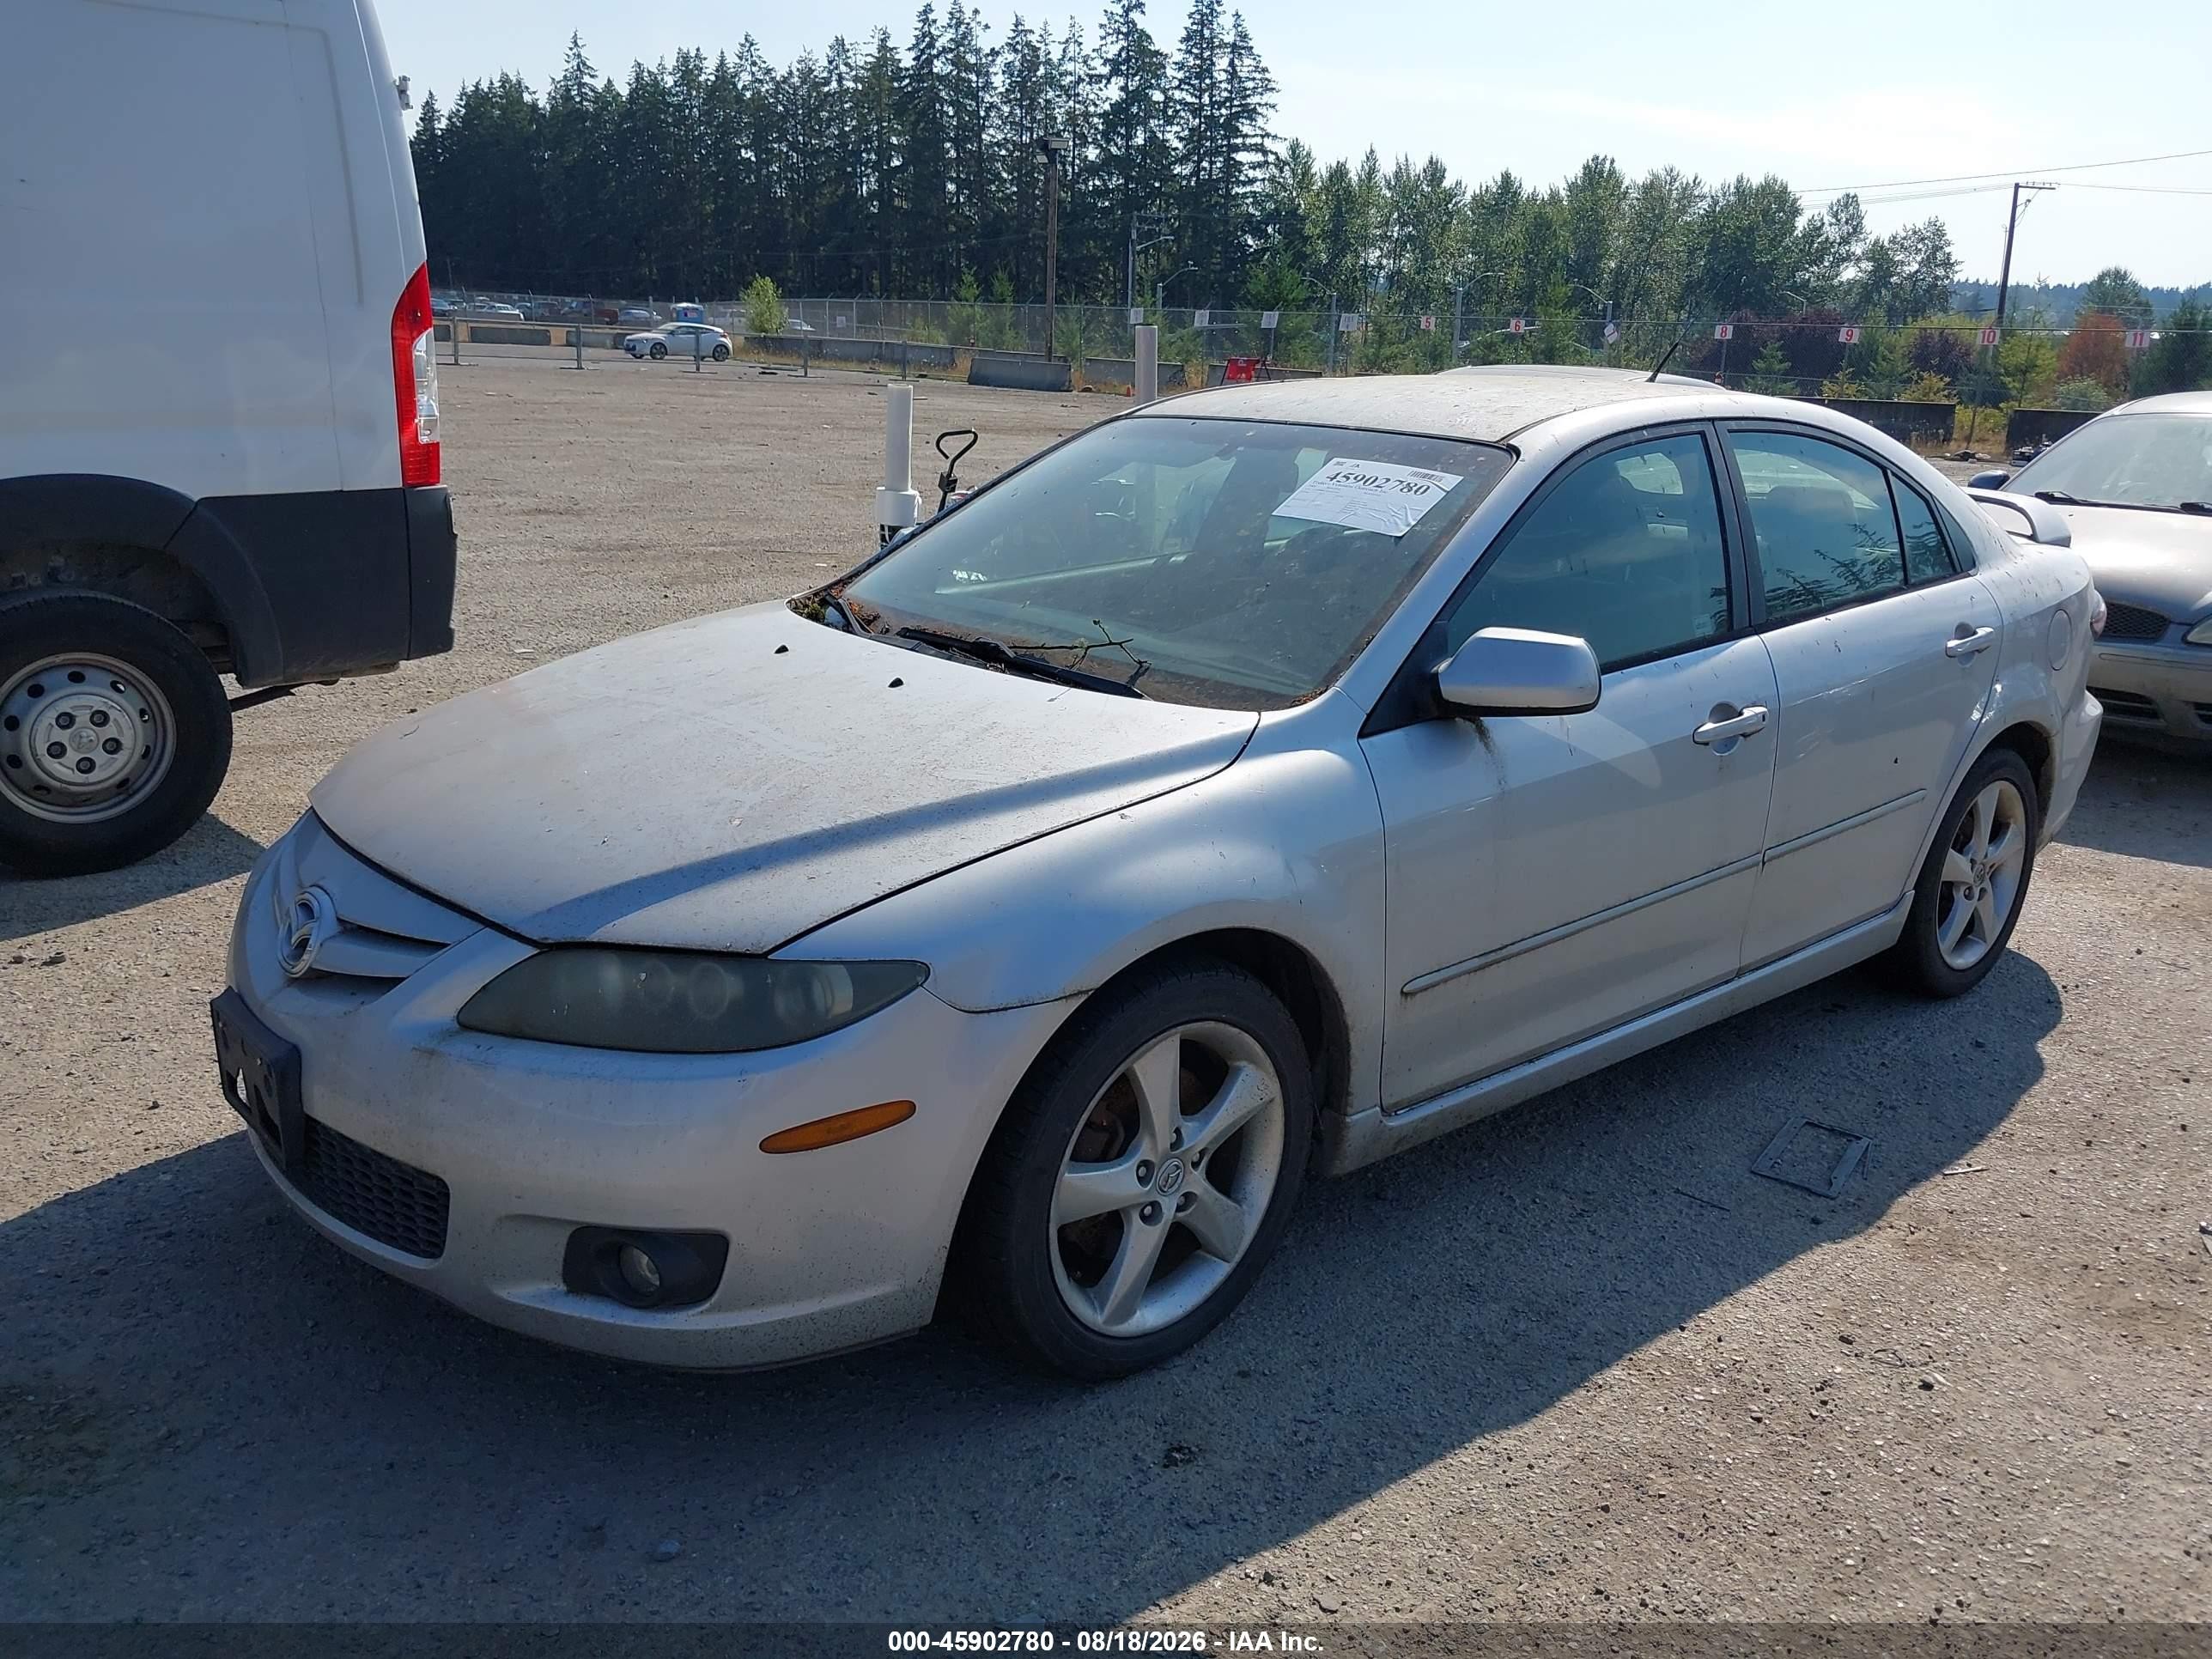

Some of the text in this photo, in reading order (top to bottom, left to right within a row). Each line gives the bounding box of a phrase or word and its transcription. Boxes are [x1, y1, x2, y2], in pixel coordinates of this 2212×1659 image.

[1425, 316, 1431, 329] 5
[1514, 320, 1521, 332] 6
[1720, 325, 1728, 338] 8
[1845, 329, 1854, 342] 9
[1981, 329, 1996, 343] 10
[2132, 331, 2144, 346] 11
[1326, 471, 1431, 496] 45902780
